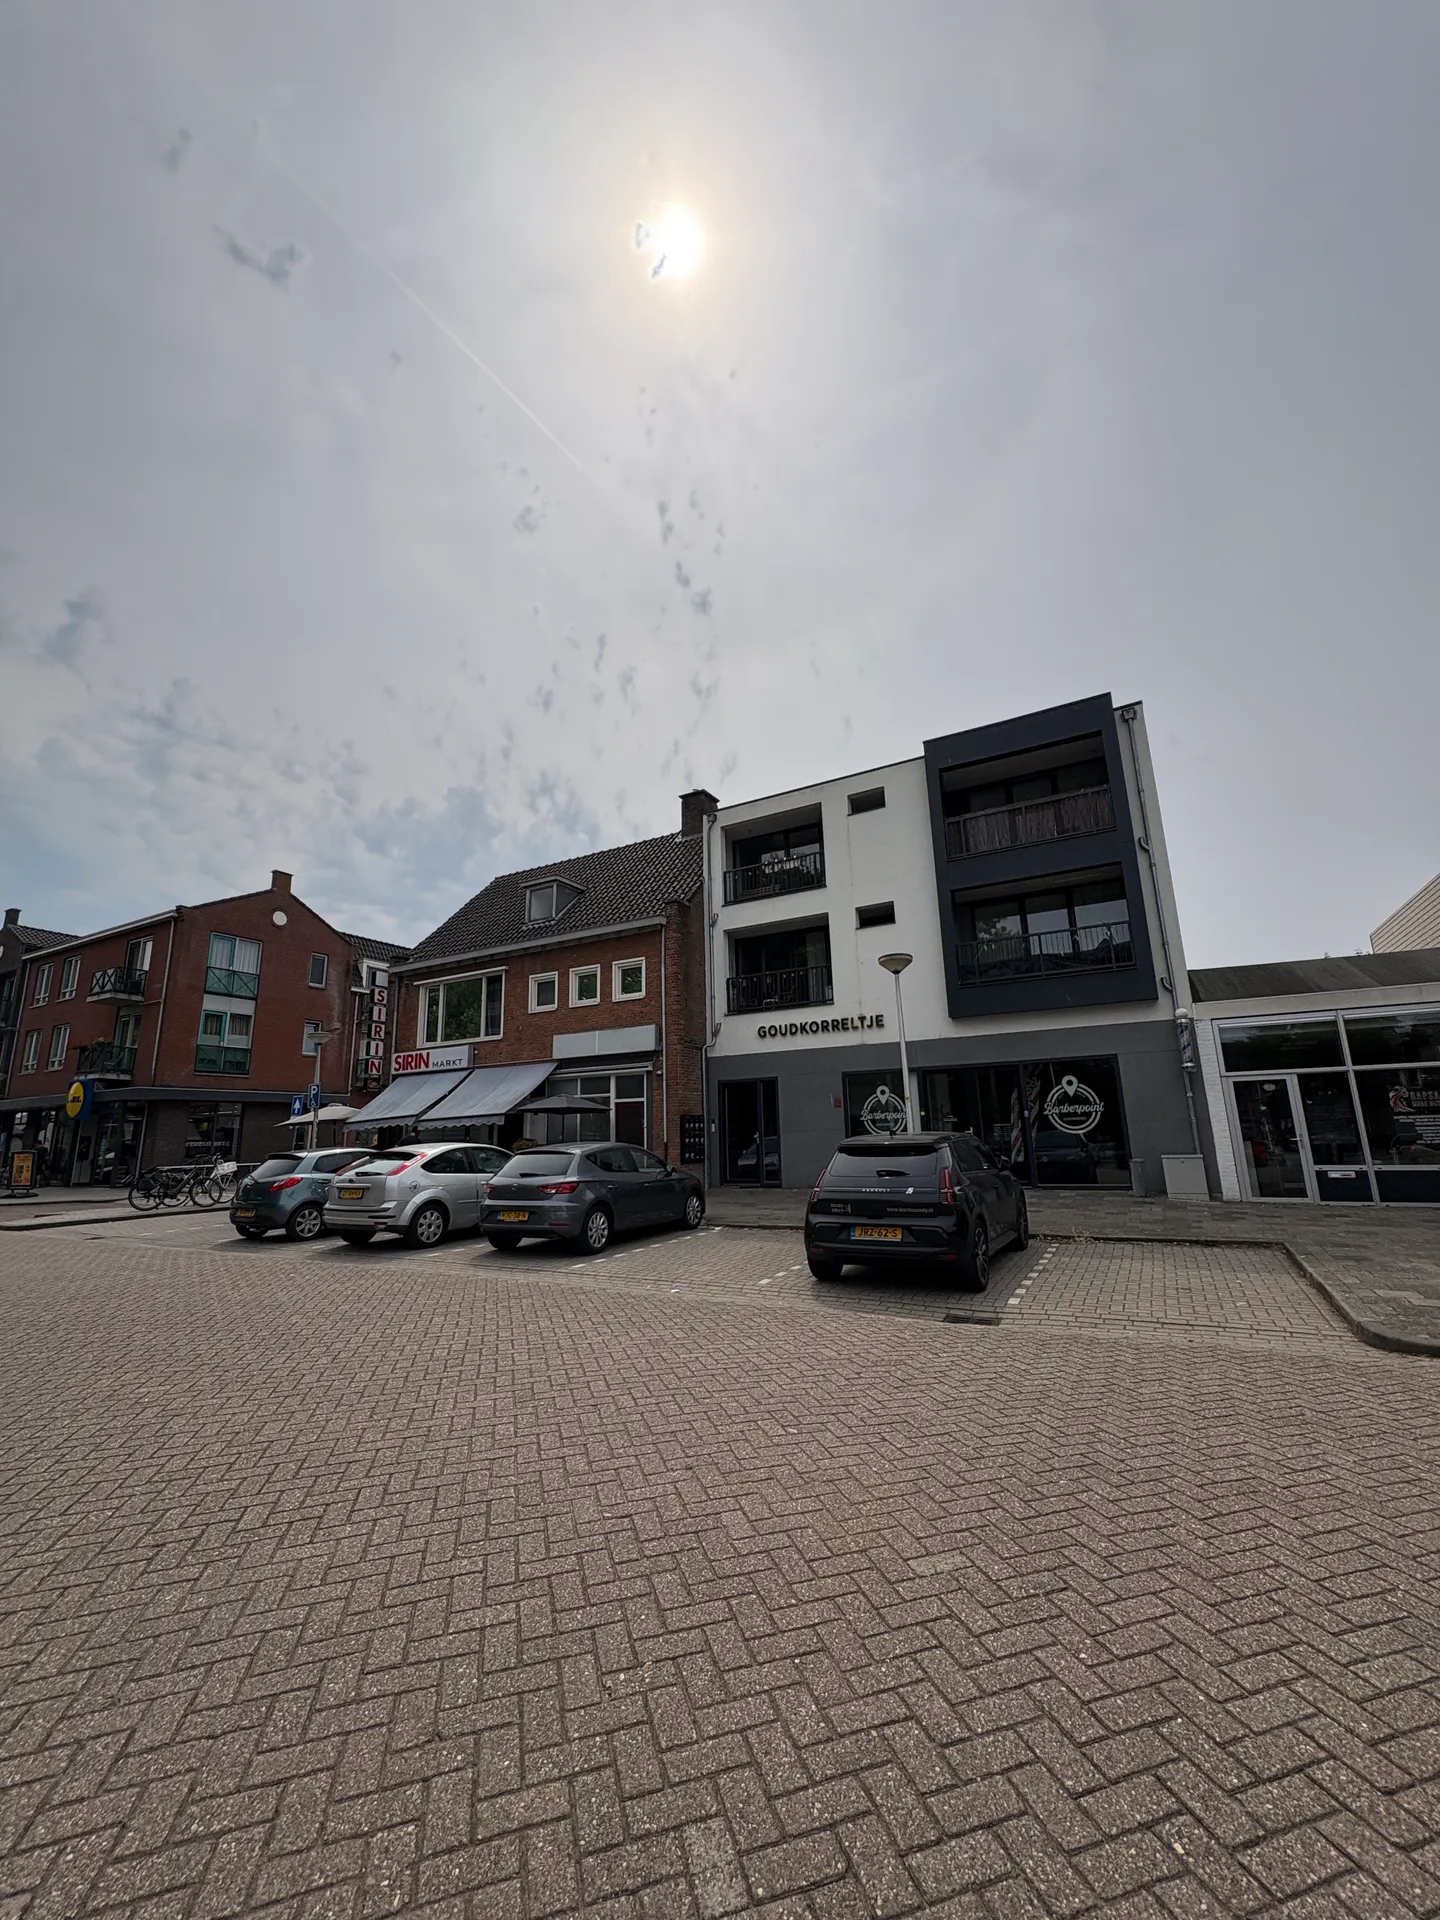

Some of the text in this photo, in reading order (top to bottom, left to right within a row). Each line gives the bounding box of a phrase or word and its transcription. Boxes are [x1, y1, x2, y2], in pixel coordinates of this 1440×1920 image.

[369, 989, 385, 1074] SIRIN
[757, 1014, 885, 1038] GOUDKORRELTJE
[394, 1051, 463, 1072] SIRIN MARKT
[1409, 1090, 1440, 1100] KAPSA
[860, 1109, 907, 1121] Barberpoin
[1043, 1101, 1105, 1115] Barberpoint
[858, 1227, 899, 1238] JRZ-62-S
